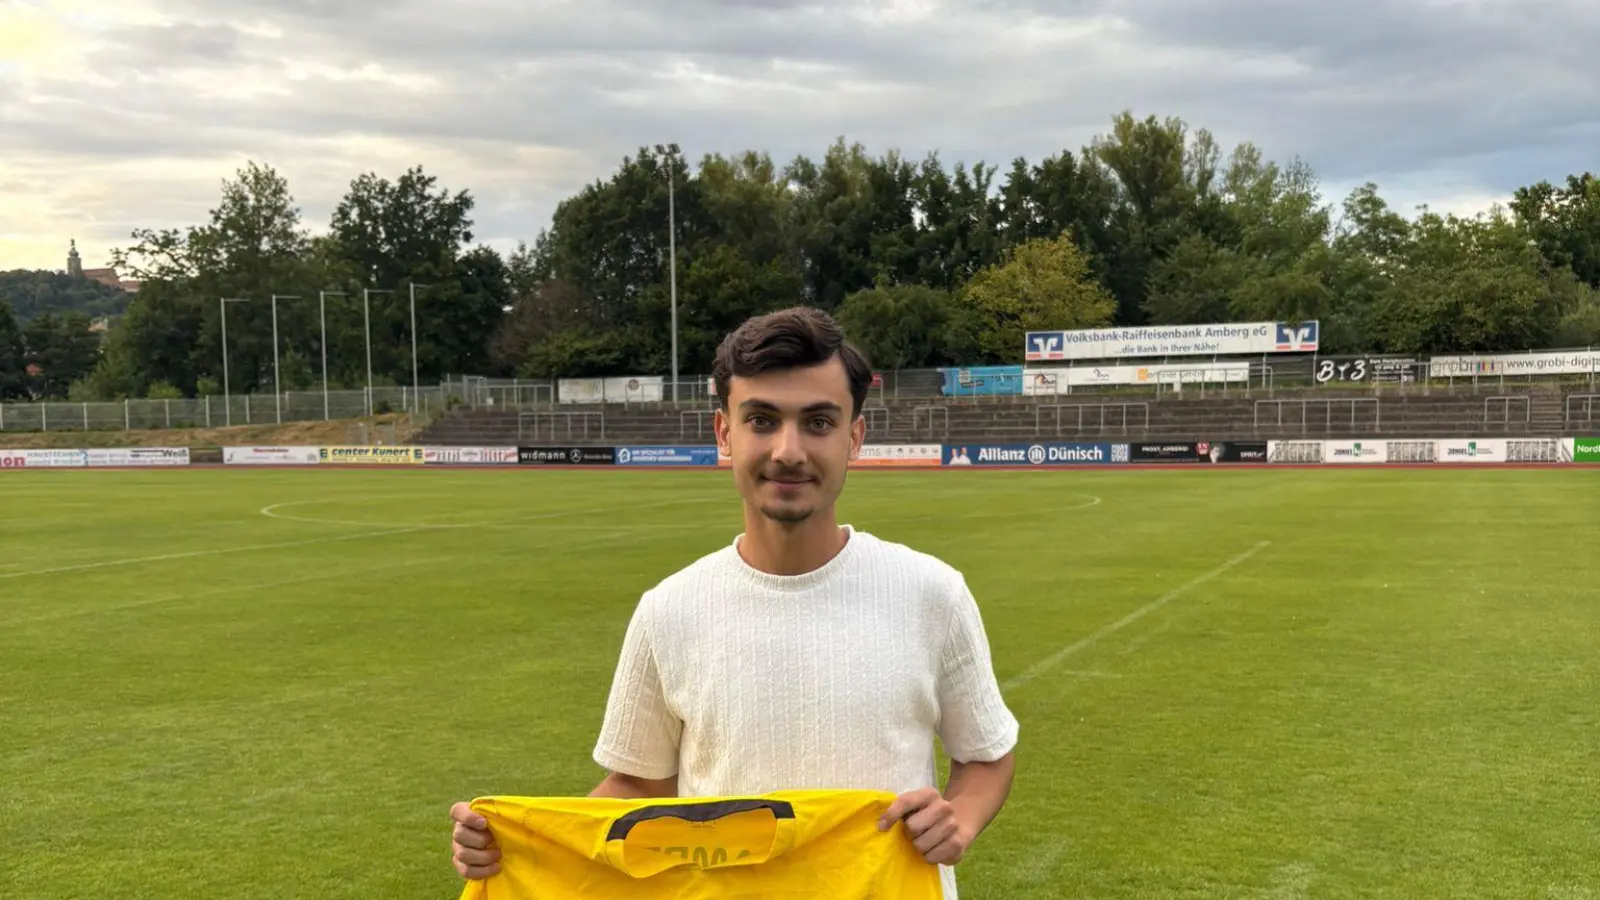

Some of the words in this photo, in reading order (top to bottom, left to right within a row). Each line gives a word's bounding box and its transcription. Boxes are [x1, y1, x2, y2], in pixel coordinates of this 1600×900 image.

[1066, 327, 1201, 342] Volksbank-Raiffeisenbank
[1205, 327, 1249, 339] Amberg
[1252, 326, 1267, 337] eG
[1137, 345, 1157, 353] Bank
[1160, 344, 1168, 352] in
[1171, 344, 1191, 352] Ihrer
[162, 449, 187, 457] Weiß
[332, 448, 370, 456] center
[372, 448, 410, 456] Kunert
[521, 450, 566, 460] widmann
[978, 447, 1025, 461] Allianz
[1048, 447, 1102, 461] Dünisch
[0, 457, 26, 468] on
